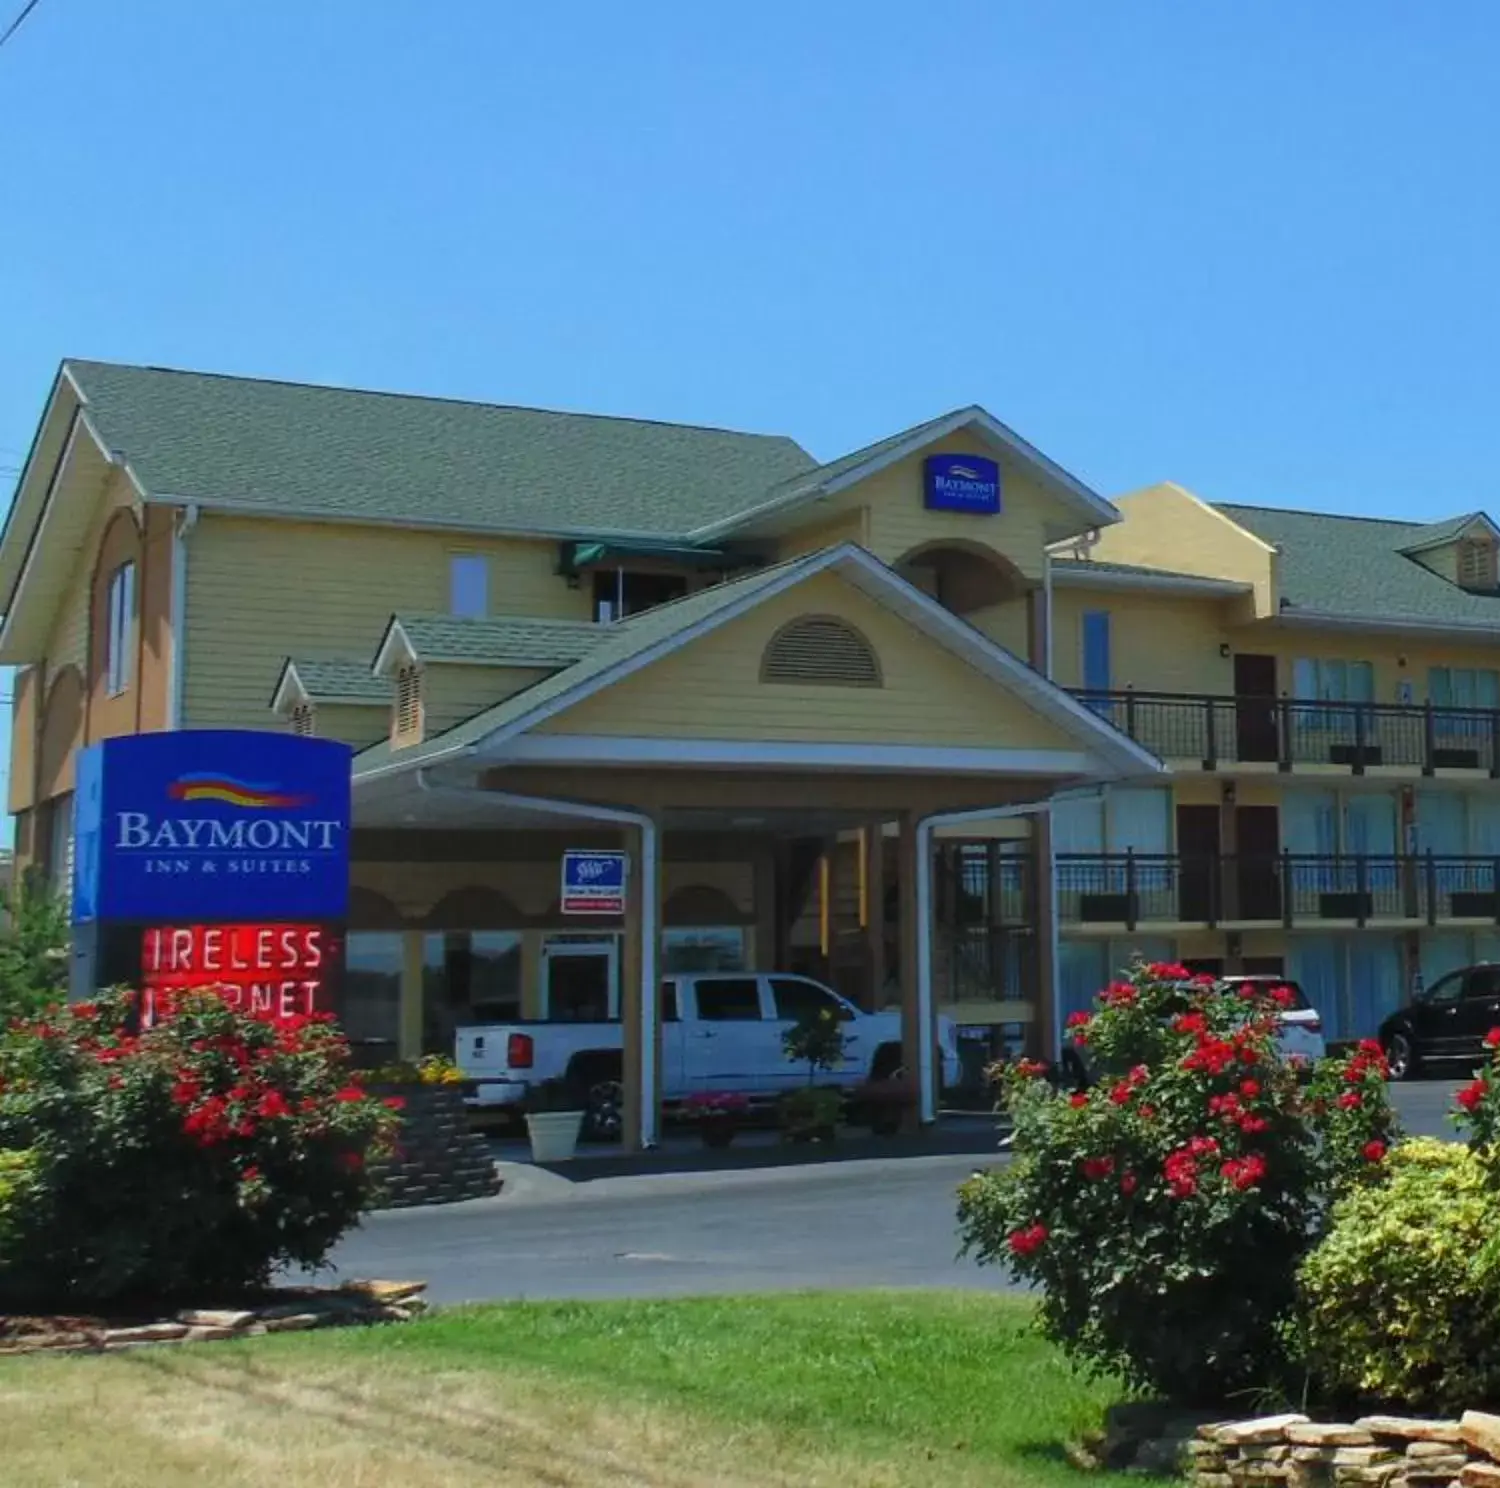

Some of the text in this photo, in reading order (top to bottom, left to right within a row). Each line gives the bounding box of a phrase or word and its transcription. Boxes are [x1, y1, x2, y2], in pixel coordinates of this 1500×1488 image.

[115, 811, 342, 849] BAYMONT
[145, 859, 311, 874] INN & SUITES
[153, 928, 321, 969] IRELESS
